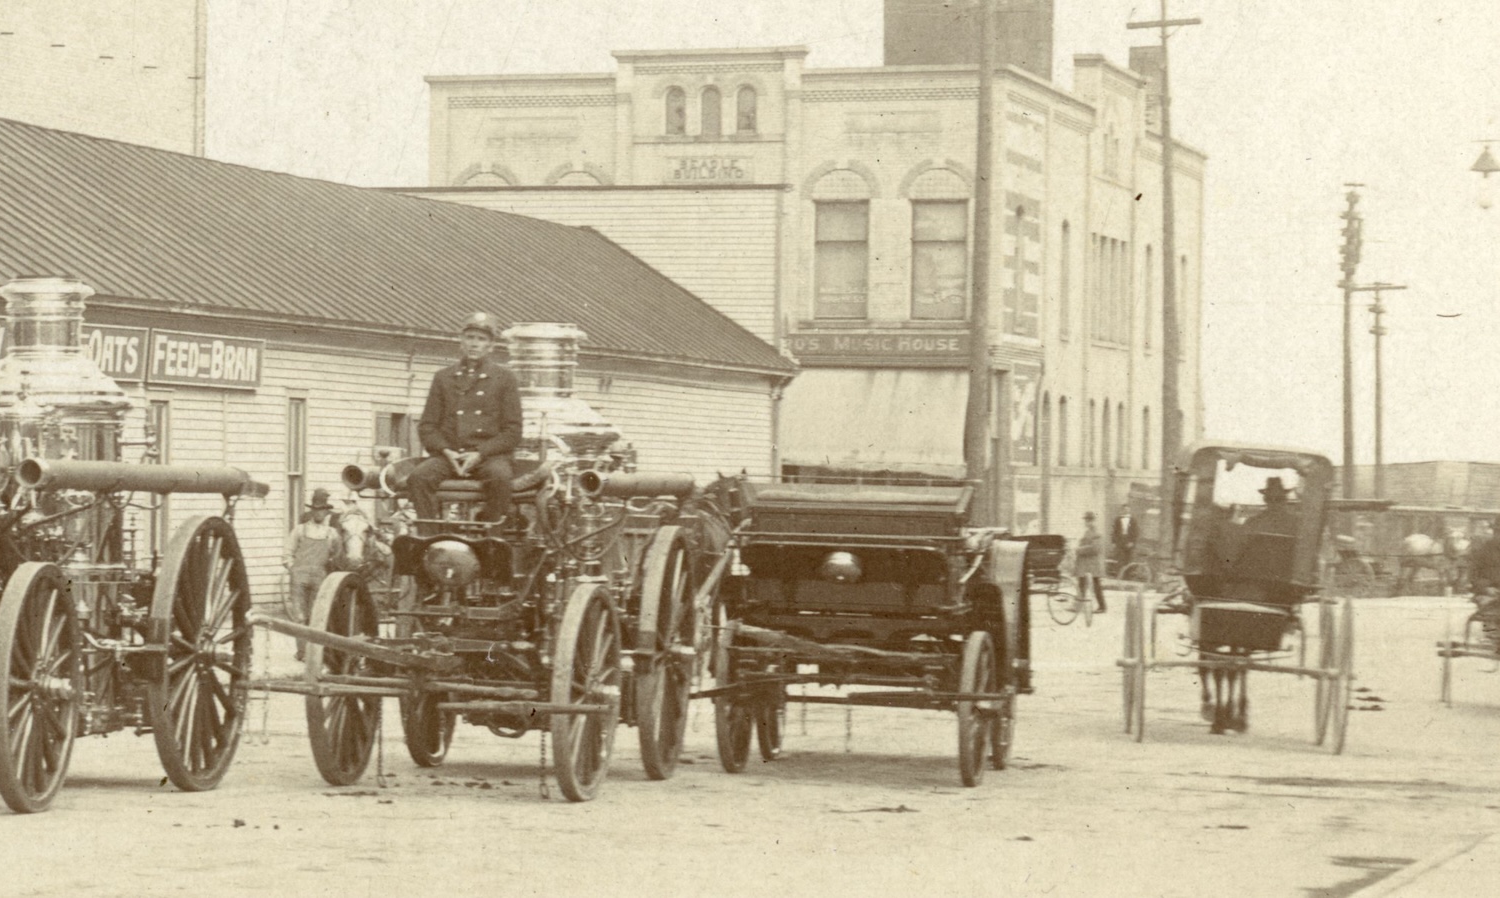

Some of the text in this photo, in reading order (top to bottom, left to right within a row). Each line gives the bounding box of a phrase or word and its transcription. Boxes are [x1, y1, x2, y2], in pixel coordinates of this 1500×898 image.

[673, 169, 744, 180] BUILDING
[85, 328, 140, 374] OATS
[833, 336, 893, 352] MUSIC
[898, 335, 960, 352] HOUSE
